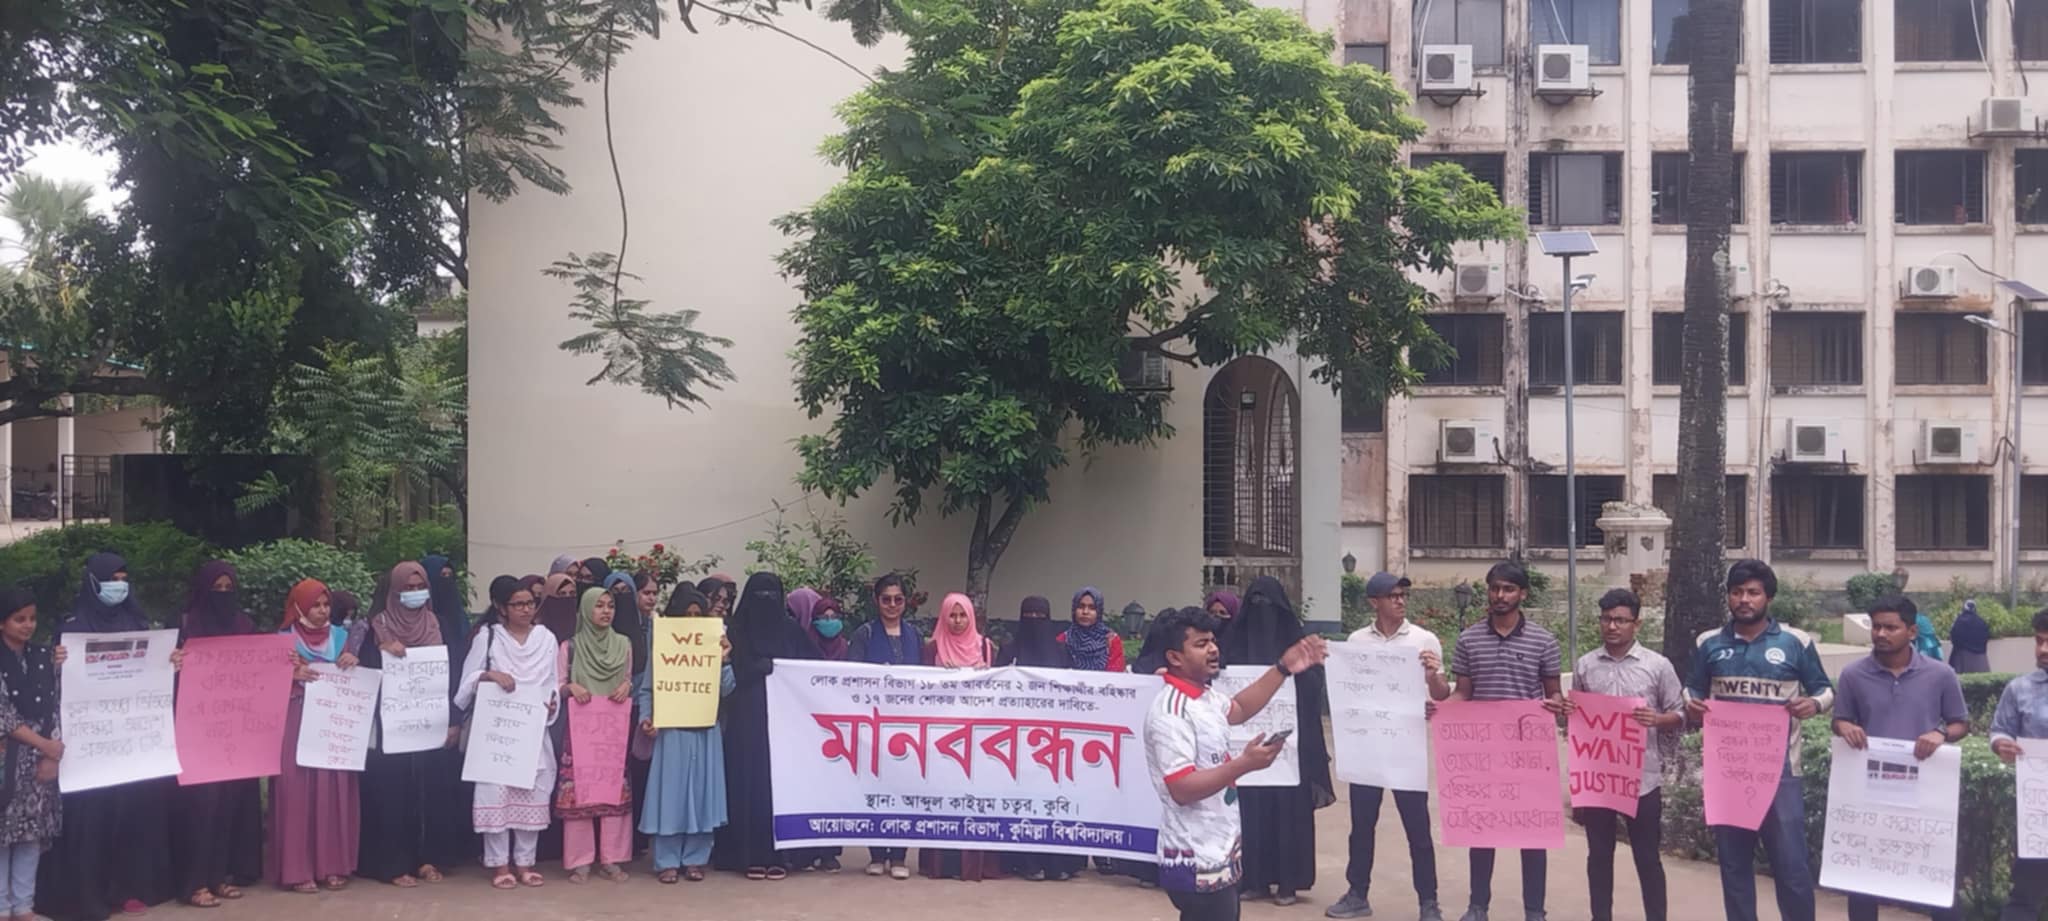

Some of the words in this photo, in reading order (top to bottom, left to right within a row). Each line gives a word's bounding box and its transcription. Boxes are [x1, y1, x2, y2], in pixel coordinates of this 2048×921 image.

[671, 632, 703, 646] WE
[661, 653, 716, 667] WANT
[656, 680, 712, 694] JUSTICE
[810, 674, 838, 687] লোক
[842, 675, 881, 688] প্রশাসন
[884, 674, 915, 690] বিভাগ
[920, 679, 935, 690] ১৮
[941, 678, 957, 690] তম
[961, 678, 1011, 691] আবর্তনের
[1016, 680, 1024, 691] ২
[1029, 680, 1046, 692] জন
[852, 694, 860, 704] ও
[865, 694, 880, 705] ১৭
[885, 694, 914, 705] জনের
[919, 694, 955, 706] শোকজ
[960, 695, 994, 707] আদেশ
[999, 697, 1055, 711] প্রত্যাহারের
[1577, 705, 1641, 743] WE
[811, 706, 1135, 789] মানববন্ধন
[1571, 736, 1645, 769] WANT
[1569, 770, 1641, 800] JUSTICE
[864, 793, 895, 809] স্থান:
[901, 794, 943, 812] আব্দুল
[808, 818, 875, 834] আয়োজনে:
[880, 818, 912, 834] লোক
[915, 819, 959, 836] প্রশাসন
[964, 817, 1004, 839] বিভাগ,
[1009, 820, 1049, 843] কুমিল্লা
